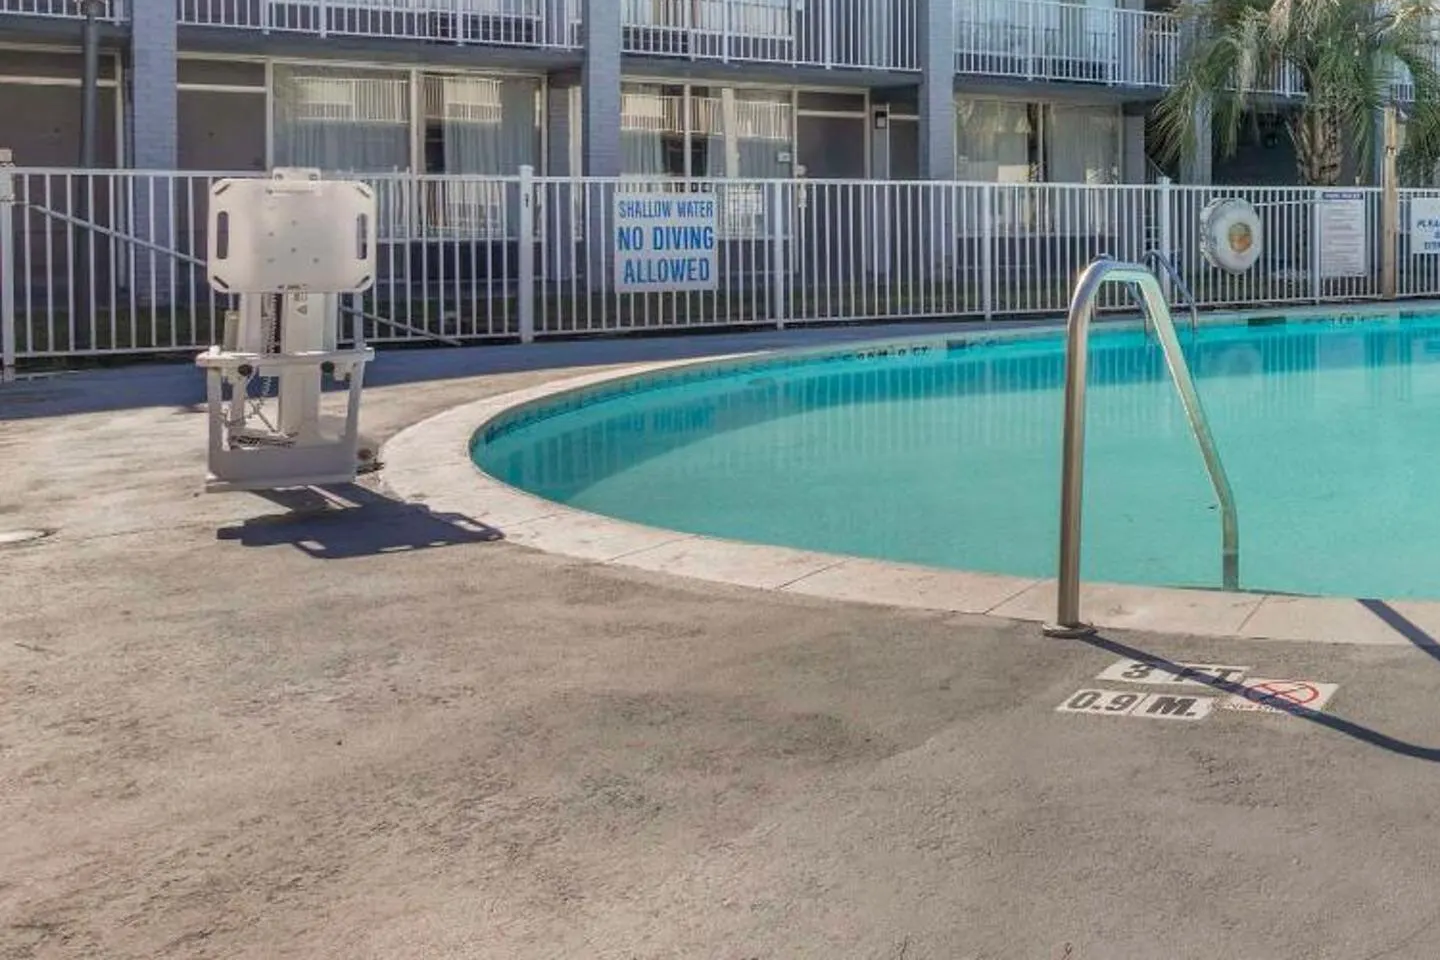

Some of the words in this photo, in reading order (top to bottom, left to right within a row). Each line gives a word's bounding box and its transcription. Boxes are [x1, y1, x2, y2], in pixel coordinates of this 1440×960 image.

[618, 200, 672, 219] SHALLOW
[677, 200, 714, 219] WATER
[617, 225, 644, 251] NO
[652, 225, 714, 251] DIVING
[623, 257, 710, 284] ALLOWED
[1121, 663, 1156, 680] 3
[1174, 667, 1244, 688] FT
[1068, 692, 1138, 712] 0.9
[1145, 694, 1198, 718] M.
